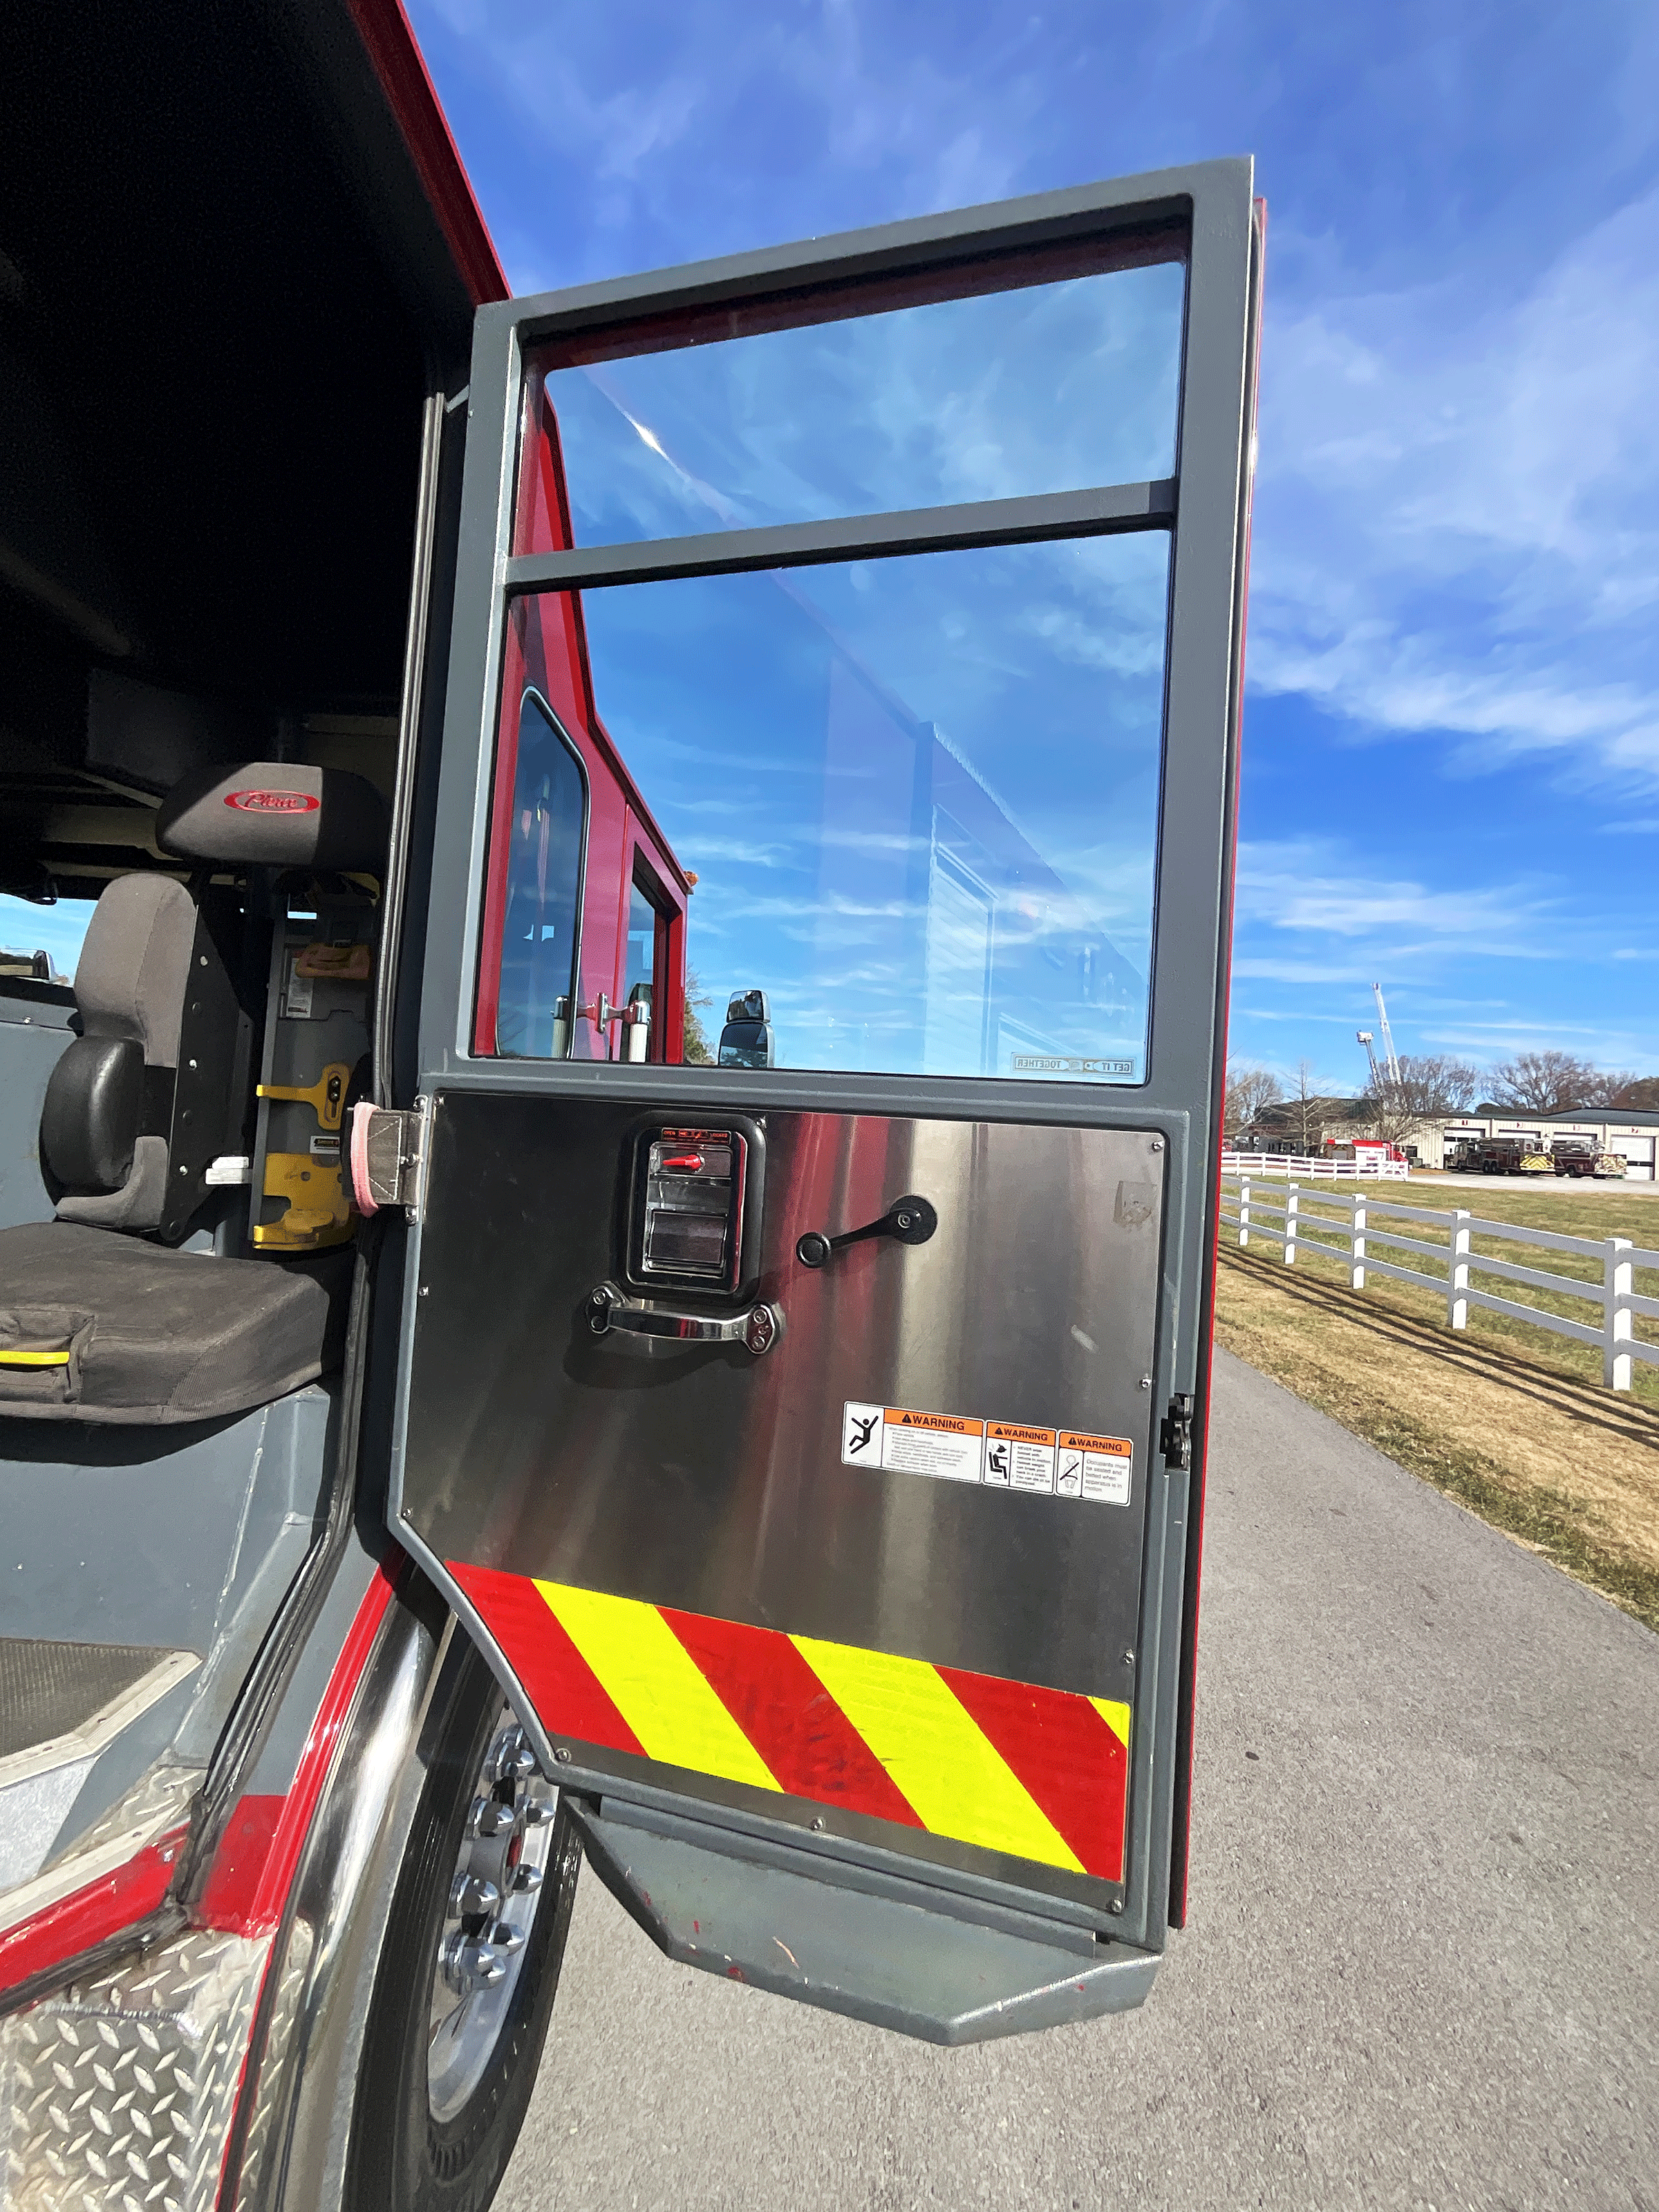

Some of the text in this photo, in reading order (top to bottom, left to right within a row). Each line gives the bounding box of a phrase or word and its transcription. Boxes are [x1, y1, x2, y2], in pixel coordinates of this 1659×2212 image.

[244, 793, 298, 808] Pierce
[912, 1414, 965, 1431] WARNING
[1004, 1428, 1048, 1441] WARNING
[1077, 1438, 1123, 1452] WARNING
